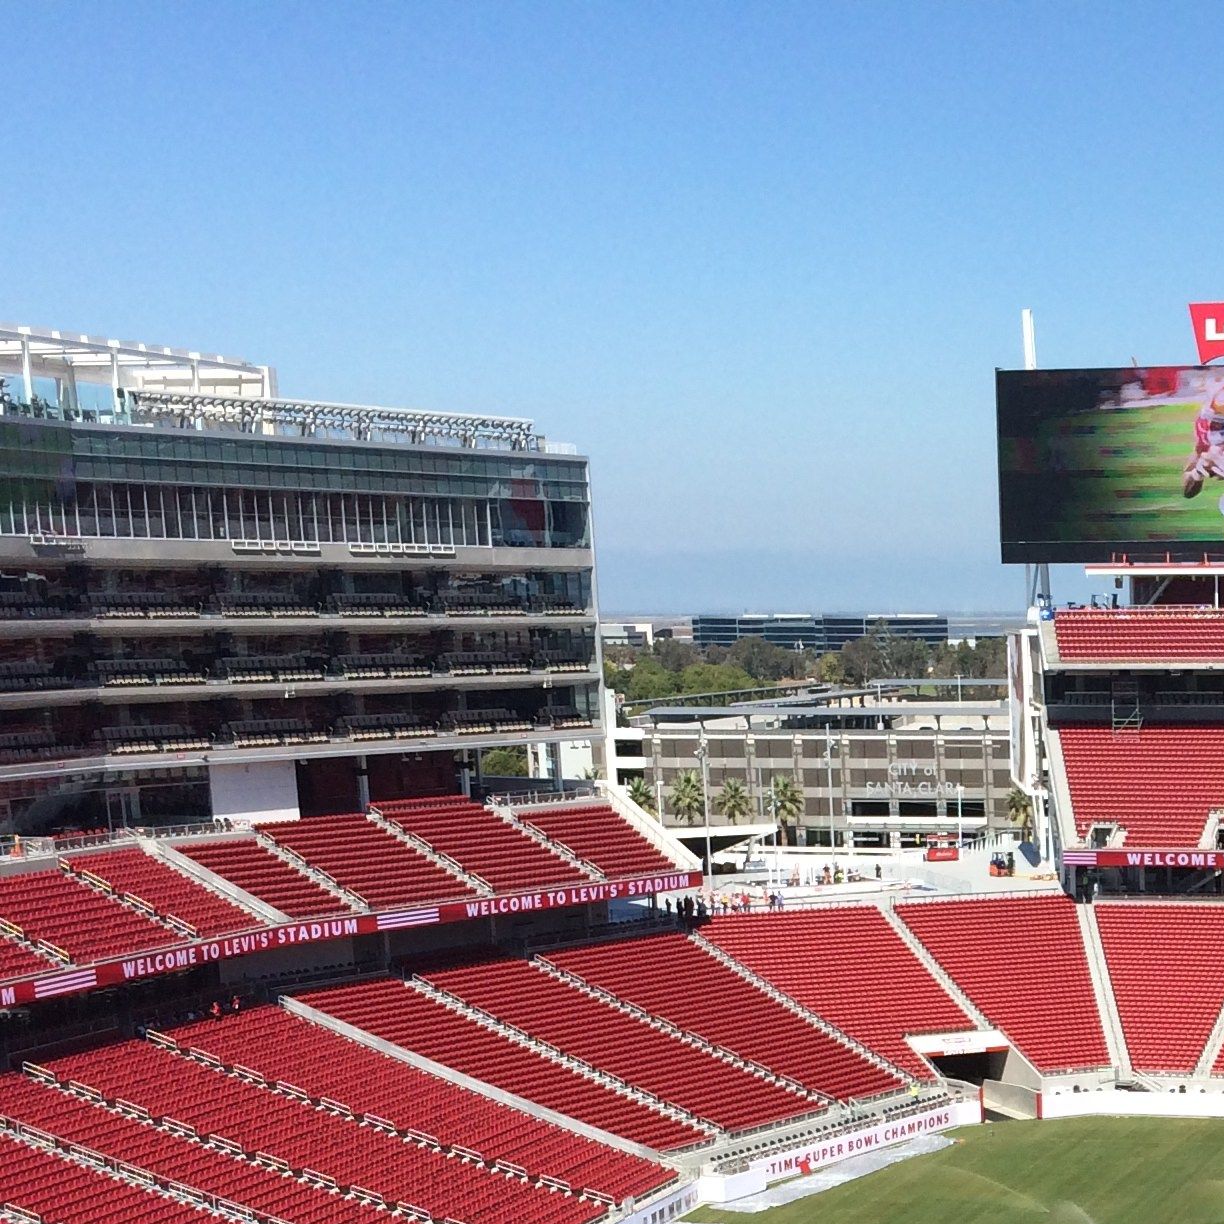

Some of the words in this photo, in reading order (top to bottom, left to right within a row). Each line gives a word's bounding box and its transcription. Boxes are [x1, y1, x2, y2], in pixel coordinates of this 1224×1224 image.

[888, 762, 917, 776] CITY
[866, 782, 912, 794] SANTA
[1126, 853, 1216, 867] WELCOME
[466, 892, 543, 918] WELCOME
[546, 889, 567, 906] TO
[628, 874, 690, 897] STADIUM
[122, 946, 197, 979] WELCOME
[202, 943, 220, 962] TO
[278, 918, 358, 945] STADIUM
[805, 1144, 843, 1164] SUPER
[848, 1133, 879, 1151] BOWL
[884, 1112, 949, 1141] CHAMPIONS
